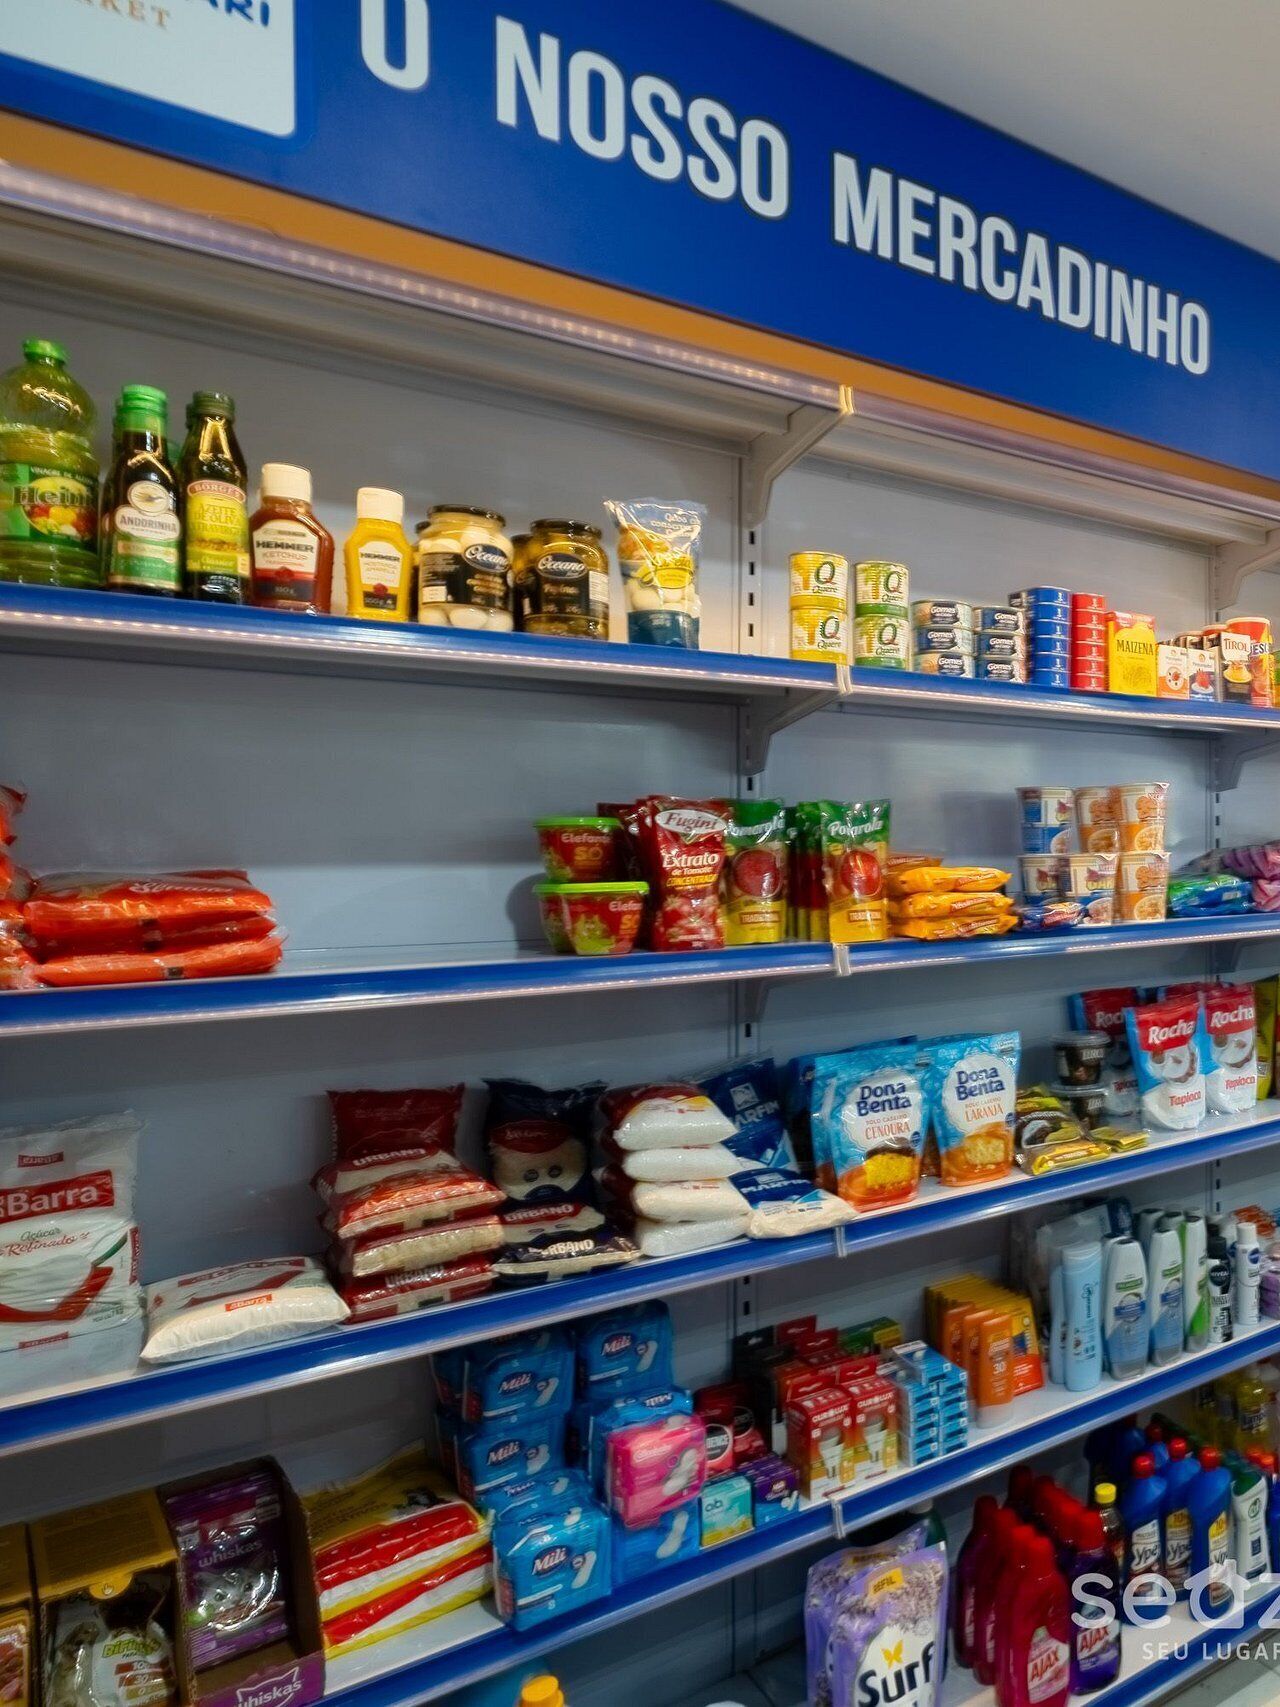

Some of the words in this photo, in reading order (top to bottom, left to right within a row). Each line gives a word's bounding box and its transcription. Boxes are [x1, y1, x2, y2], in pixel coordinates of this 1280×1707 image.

[495, 14, 790, 219] NOSSO
[832, 151, 1211, 376] MERCADINHO
[120, 515, 178, 534] ANDORINHA
[256, 541, 314, 553] HEMMER
[538, 556, 585, 575] Oceano
[1116, 639, 1154, 656] MAIZENA
[1223, 638, 1250, 652] TIROL
[665, 811, 718, 833] Fugini
[663, 852, 719, 868] Extrato
[1210, 1006, 1253, 1028] Rocha
[1149, 1018, 1195, 1045] Rocha
[956, 1066, 999, 1086] Dona
[1224, 1075, 1256, 1090] Tapioca
[860, 1082, 906, 1101] Dona
[955, 1078, 1006, 1101] Benta
[1169, 1089, 1202, 1107] Tapioca
[855, 1095, 912, 1117] Benta
[965, 1105, 1004, 1123] LARANJA
[865, 1121, 911, 1141] CENOURA
[353, 1147, 427, 1167] URBANO
[8, 1183, 99, 1217] Barra
[8, 1234, 77, 1257] Refinado
[602, 1335, 632, 1356] Mili
[499, 1373, 532, 1394] Mili
[487, 1441, 520, 1464] Mili
[199, 1540, 264, 1568] whiskas
[532, 1547, 567, 1575] Mili
[1079, 1625, 1109, 1652] AJAX
[857, 1640, 936, 1707] Surf
[1029, 1646, 1059, 1682] AJAX
